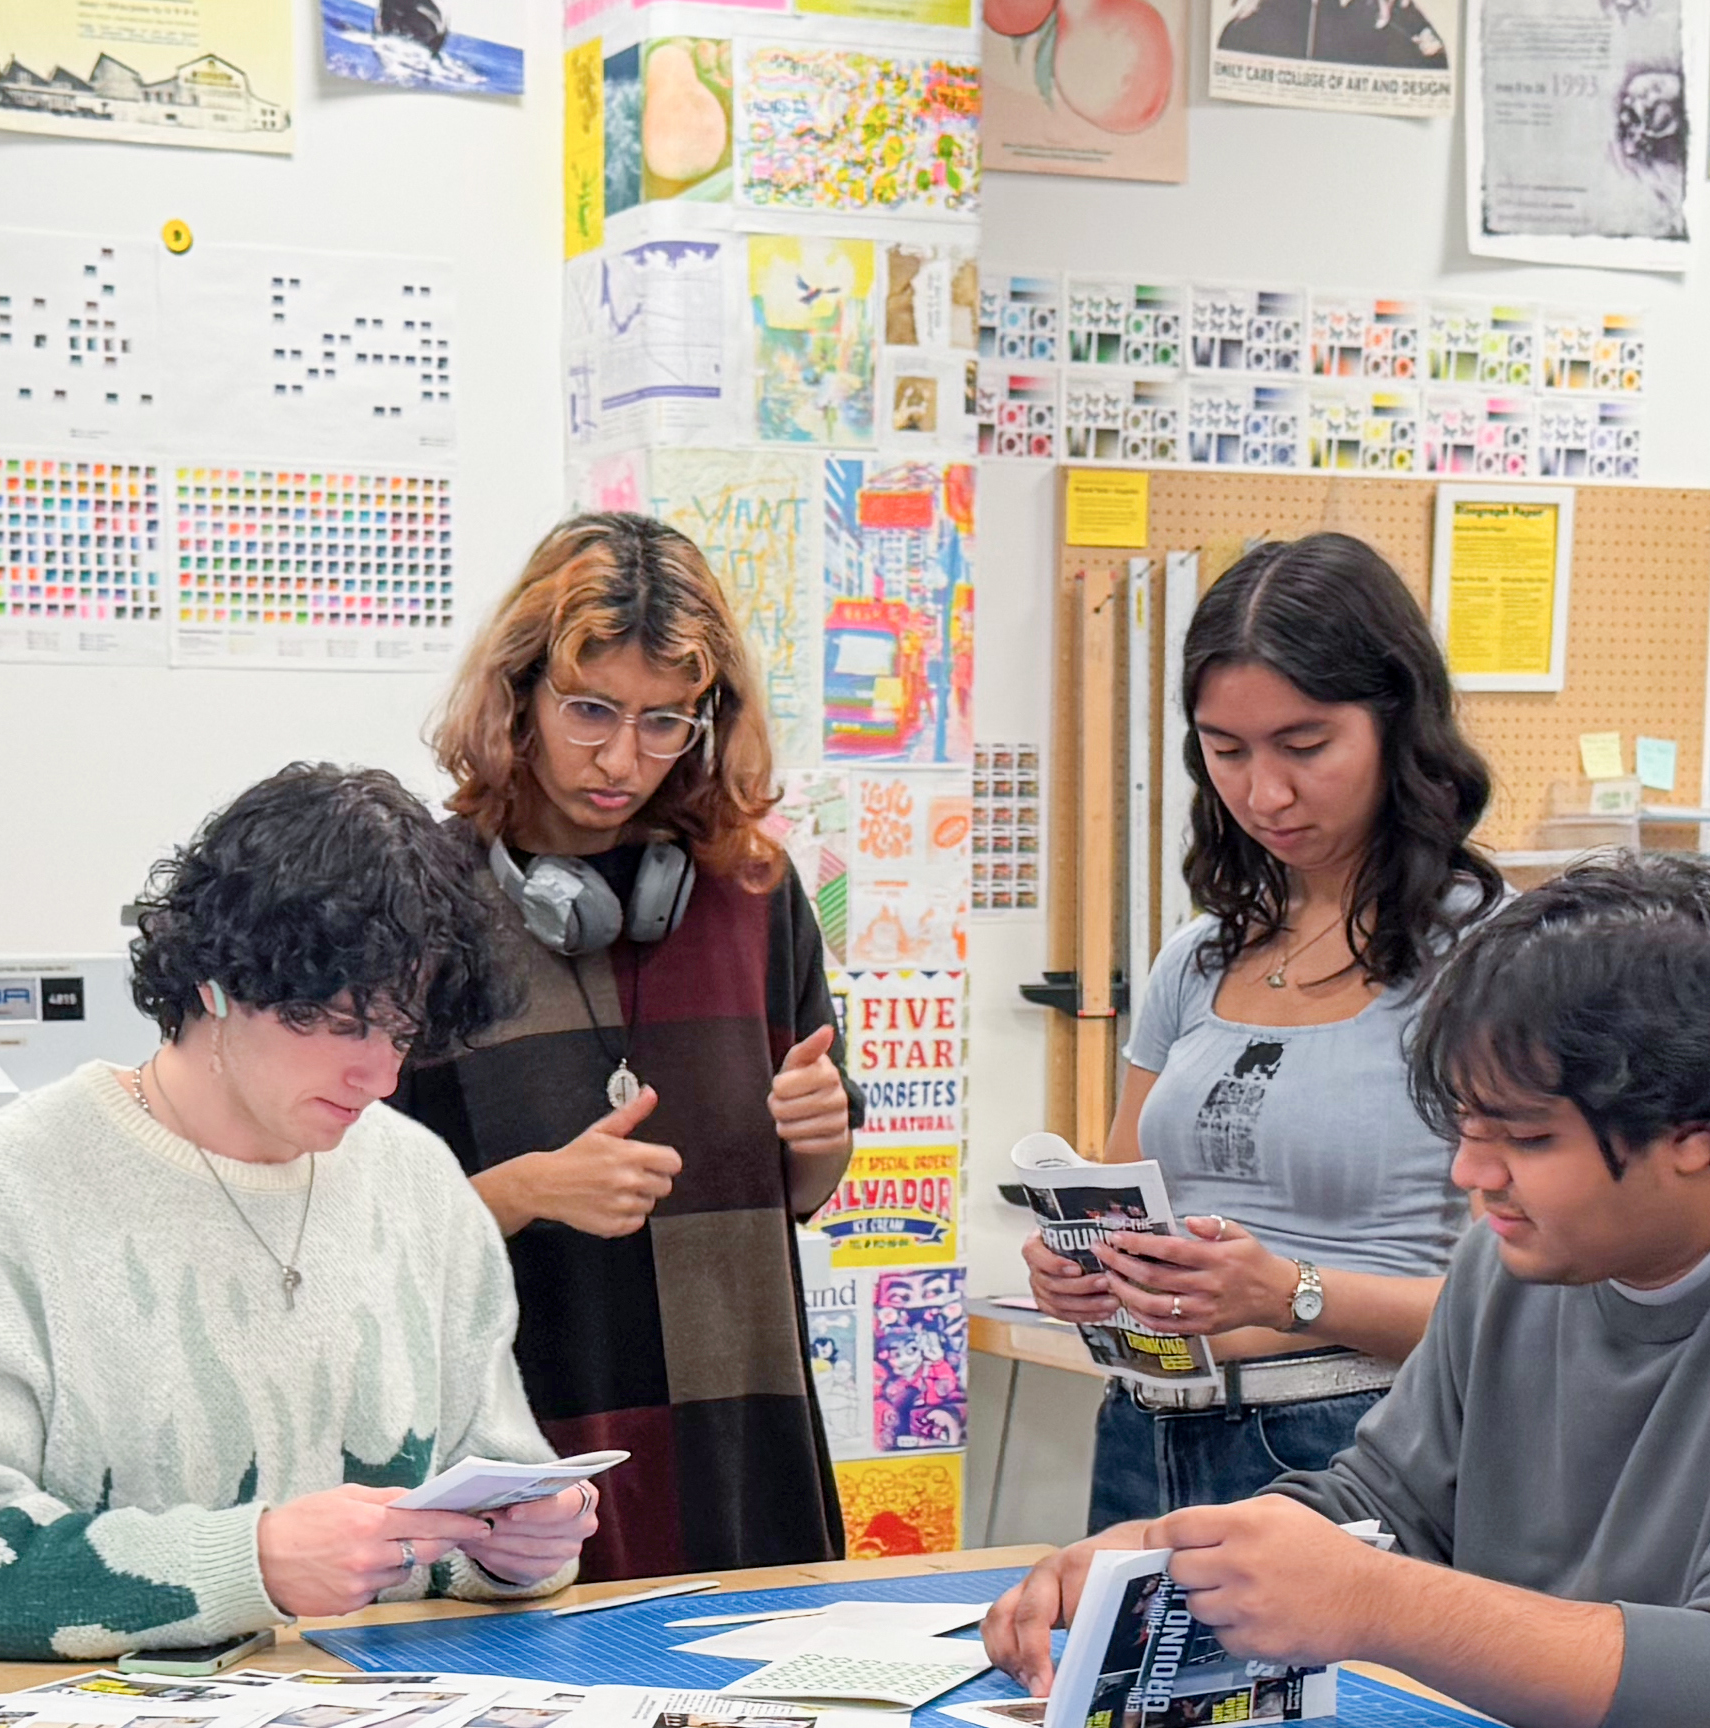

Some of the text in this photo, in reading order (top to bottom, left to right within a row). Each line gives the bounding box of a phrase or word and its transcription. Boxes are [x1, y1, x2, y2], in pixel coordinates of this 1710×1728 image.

[1246, 65, 1274, 83] CARR
[1328, 75, 1343, 90] OF
[1346, 77, 1369, 92] ART
[1372, 79, 1399, 94] AND
[1402, 80, 1452, 96] DESIGN
[861, 997, 956, 1031] FIVE
[860, 1038, 955, 1071] STAR
[890, 1114, 956, 1133] NATURAL
[810, 1176, 952, 1224] ALVADOR
[870, 1217, 907, 1233] CREAM
[1143, 1609, 1193, 1714] GROUND
